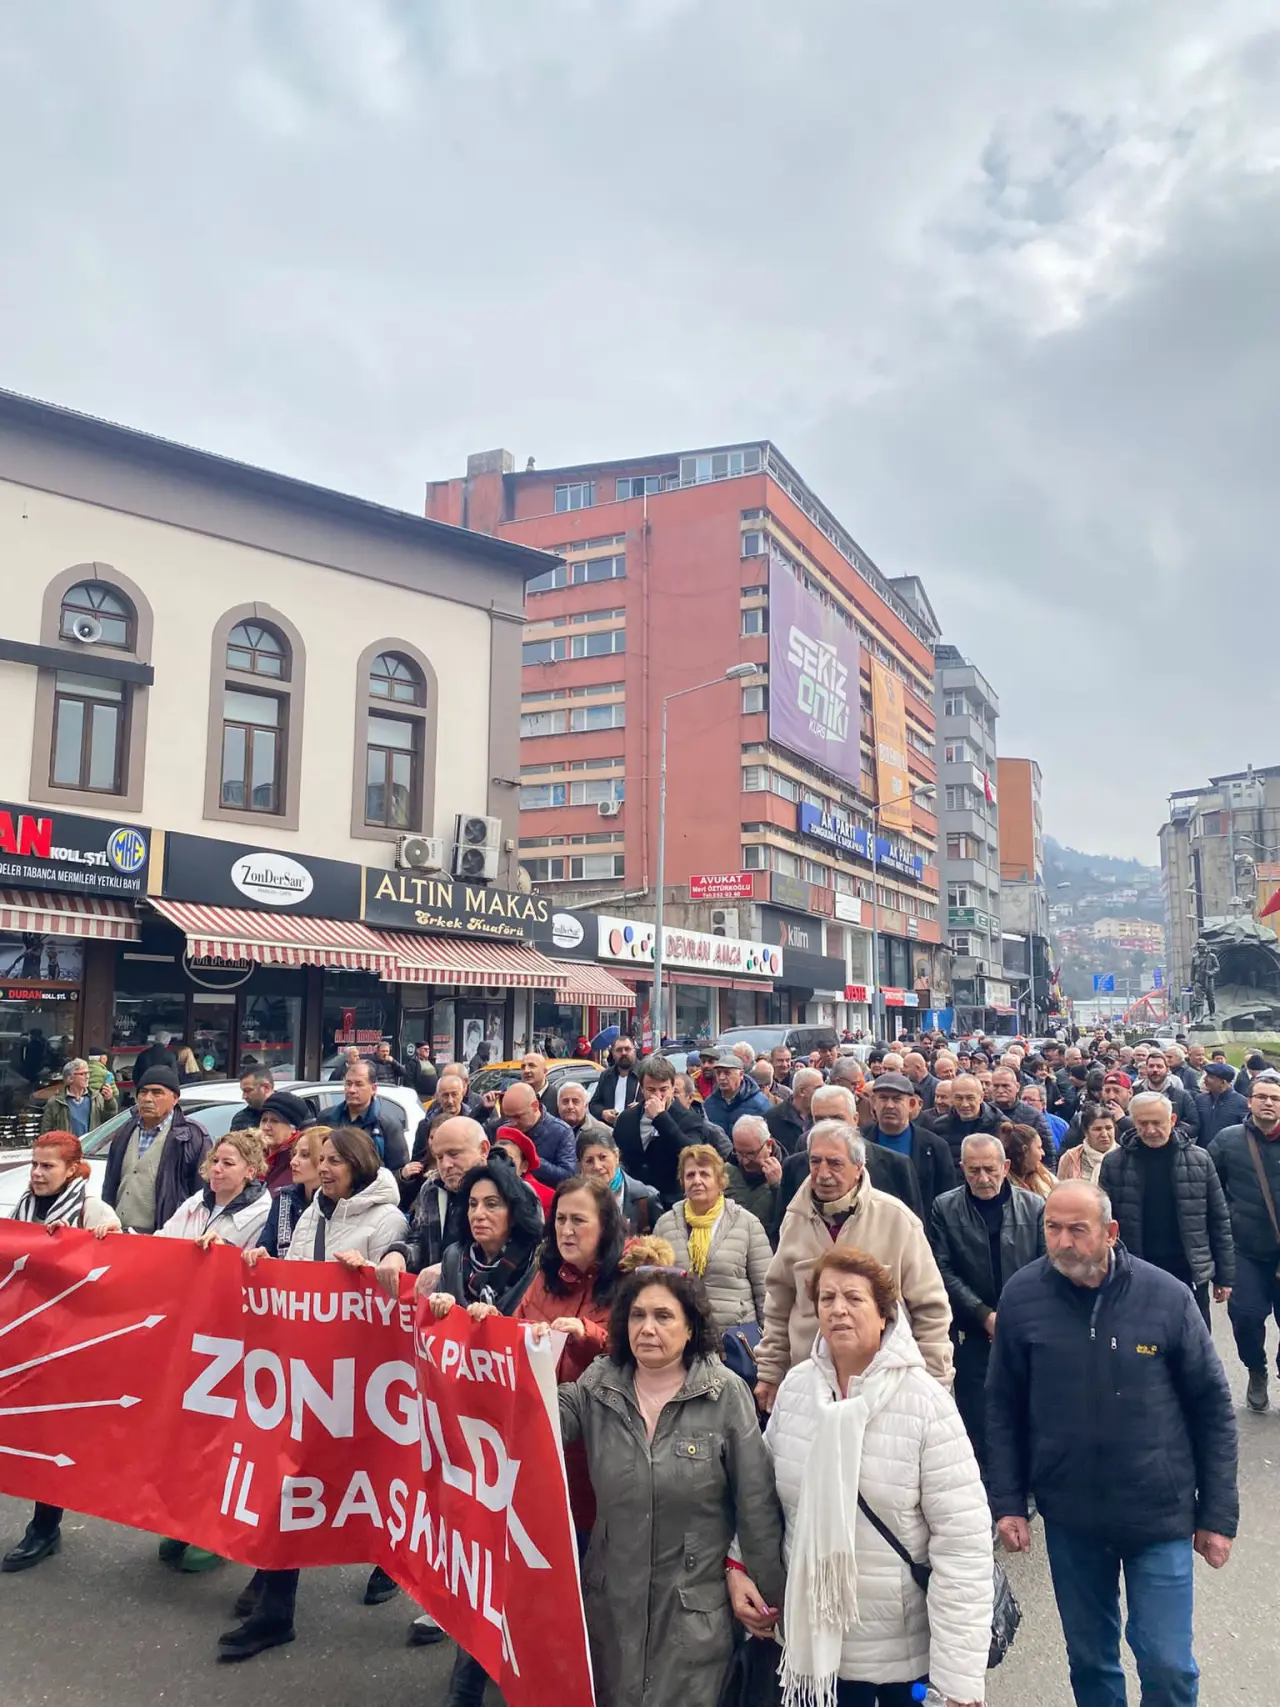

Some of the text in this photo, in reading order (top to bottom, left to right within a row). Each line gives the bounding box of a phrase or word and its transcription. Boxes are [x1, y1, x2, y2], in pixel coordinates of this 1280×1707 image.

[821, 811, 833, 832] AK
[115, 832, 143, 868] MKE
[22, 866, 56, 881] TABANCA
[57, 869, 97, 886] MERMİLERİ
[97, 875, 123, 888] YETKİLİ
[241, 865, 303, 889] ZonDerSan
[699, 875, 743, 885] AVUKAT
[374, 873, 548, 923] ALTIN MAKAS
[414, 910, 524, 937] Erkek Kuaförü
[788, 924, 809, 949] kilim
[8, 989, 42, 1000] DURAN
[241, 1286, 418, 1333] UMHURİYE
[441, 1339, 516, 1391] PARTİ
[220, 1442, 260, 1528] İL
